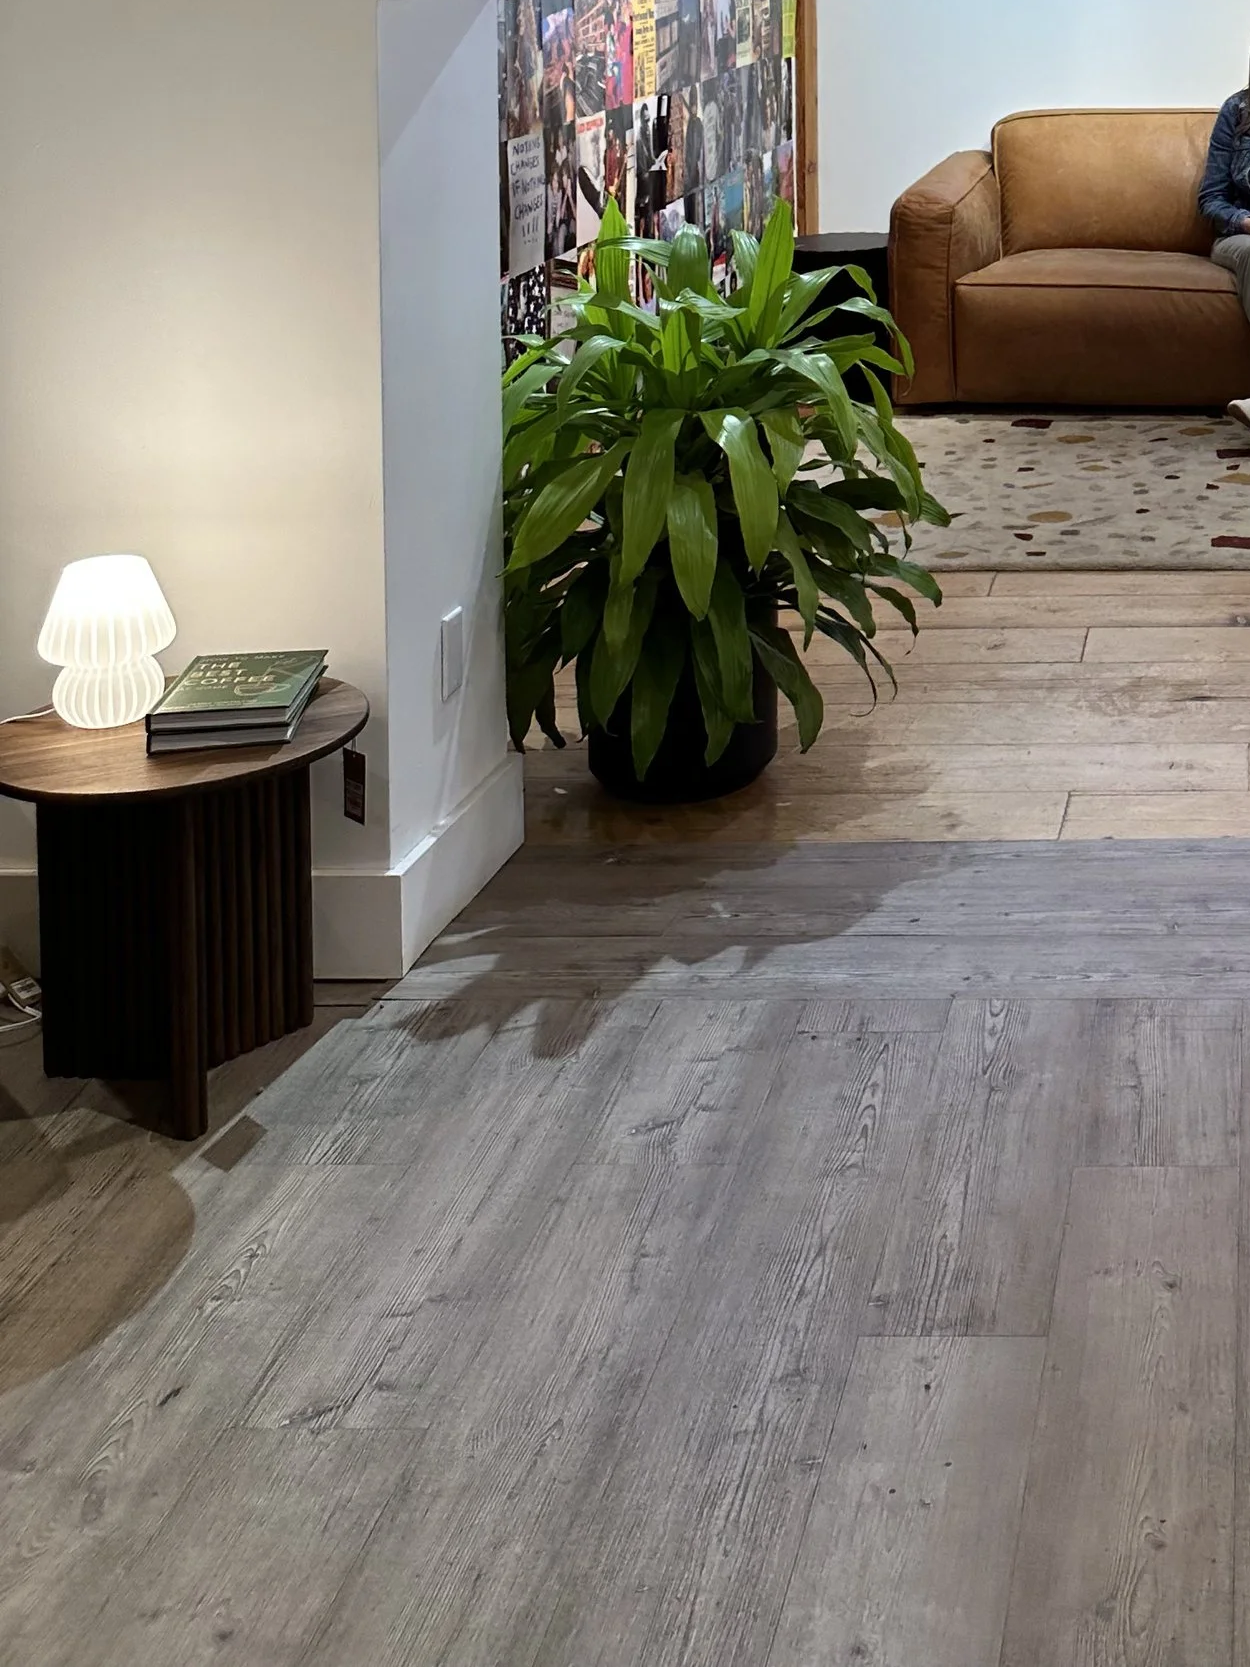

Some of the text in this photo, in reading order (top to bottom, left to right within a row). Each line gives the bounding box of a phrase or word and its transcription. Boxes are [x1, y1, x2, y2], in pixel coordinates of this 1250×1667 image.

[199, 661, 242, 670] THE
[190, 669, 249, 679] BEST
[184, 675, 277, 686] COFFEE
